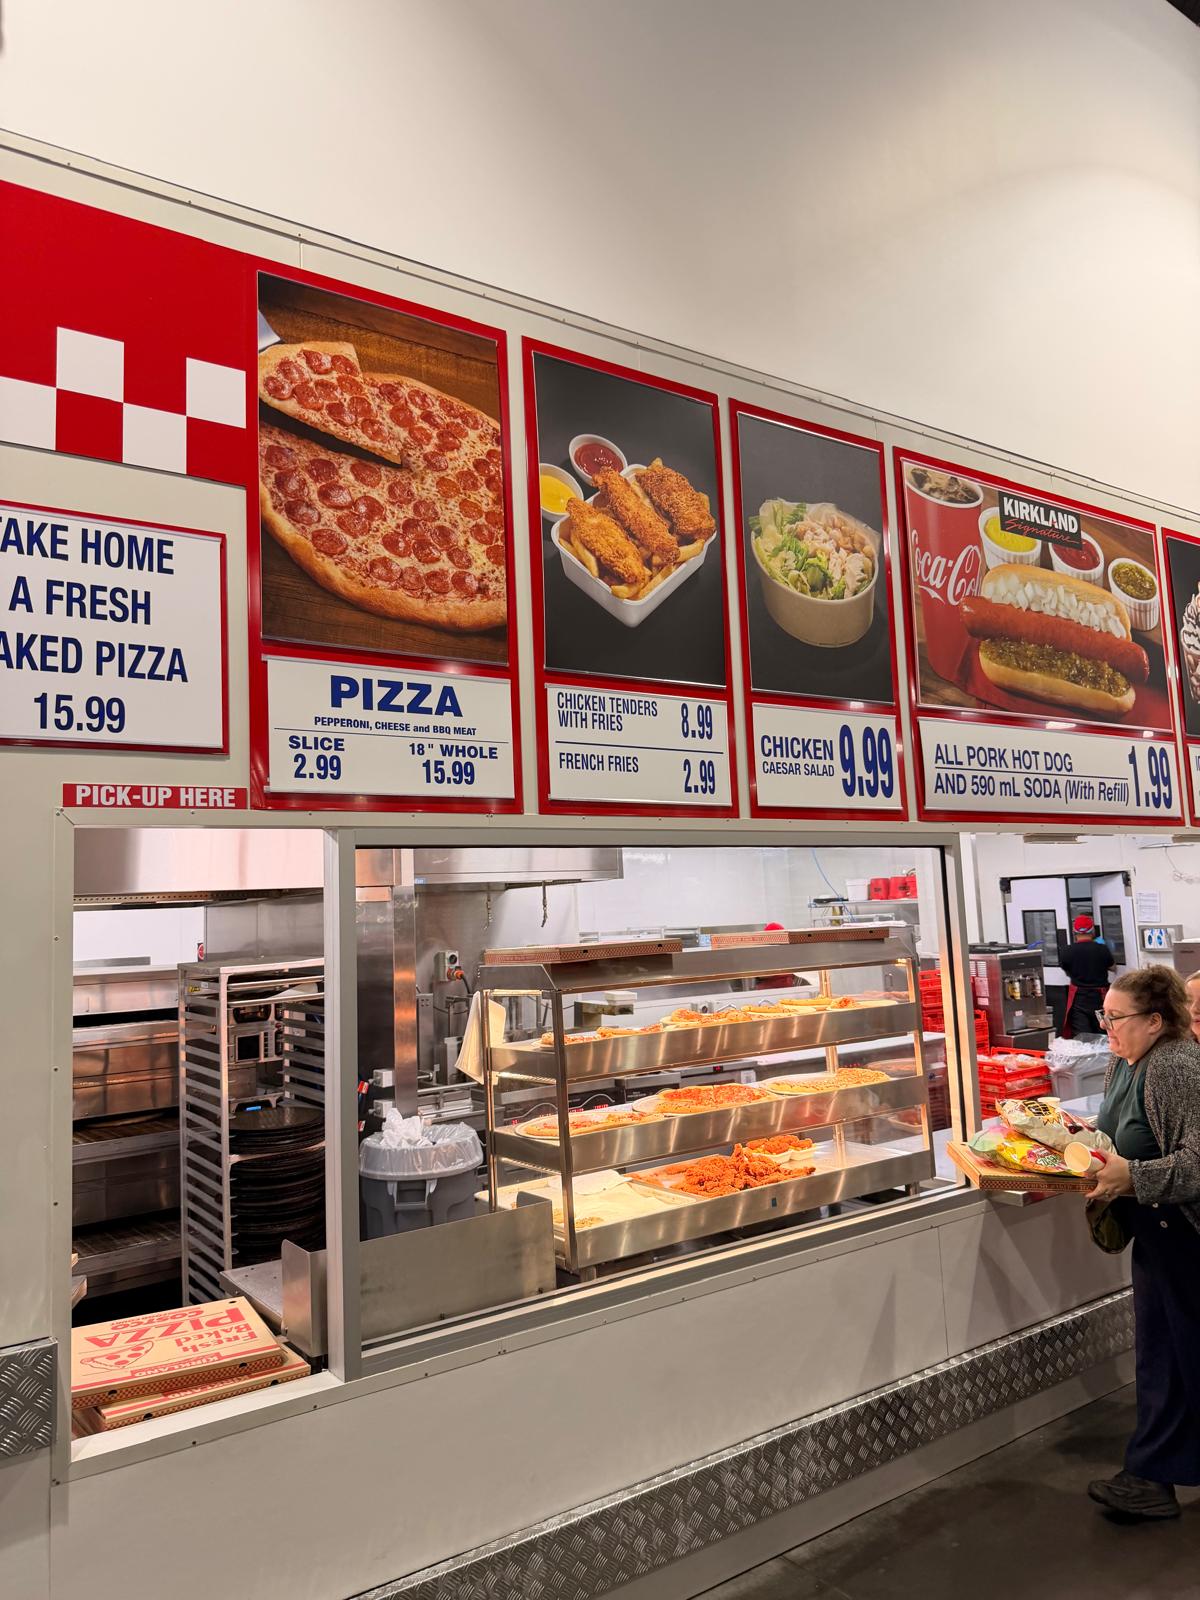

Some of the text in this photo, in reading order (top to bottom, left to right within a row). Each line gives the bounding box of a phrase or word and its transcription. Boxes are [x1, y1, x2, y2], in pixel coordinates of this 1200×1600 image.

[1003, 496, 1079, 534] KIRKLAND
[1005, 518, 1080, 544] Signature
[0, 516, 174, 574] AKE HOME
[9, 576, 150, 624] A FRESH
[96, 641, 188, 682] PIZZA
[331, 675, 463, 717] PIZZA
[558, 692, 656, 716] CHICKEN TENDERS
[34, 693, 125, 733] 15.99
[314, 716, 477, 736] PEPPERONI, CHEESE and BBQ MEAT
[557, 710, 622, 731] WITH FRIES
[681, 704, 712, 739] 8.99
[289, 735, 344, 751] SLICE
[440, 744, 498, 760] WHOLE
[761, 735, 833, 760] CHICKEN
[294, 754, 341, 780] 2.99
[560, 753, 638, 772] FRENCH FRIES
[763, 762, 834, 776] CAESAR SALAD
[839, 725, 893, 798] 9.99
[935, 744, 1072, 772] ALL PORK HOT DOG
[422, 760, 476, 785] 15.99
[684, 759, 715, 794] 2.99
[1128, 748, 1172, 809] 1.99
[76, 785, 236, 808] PICK-UP HERE
[935, 773, 1129, 806] AND 590 mL SODA (With Refill)
[84, 1307, 246, 1348] PIZZA
[111, 1309, 205, 1331] COSTCO
[134, 1356, 219, 1378] KIRKLAND
